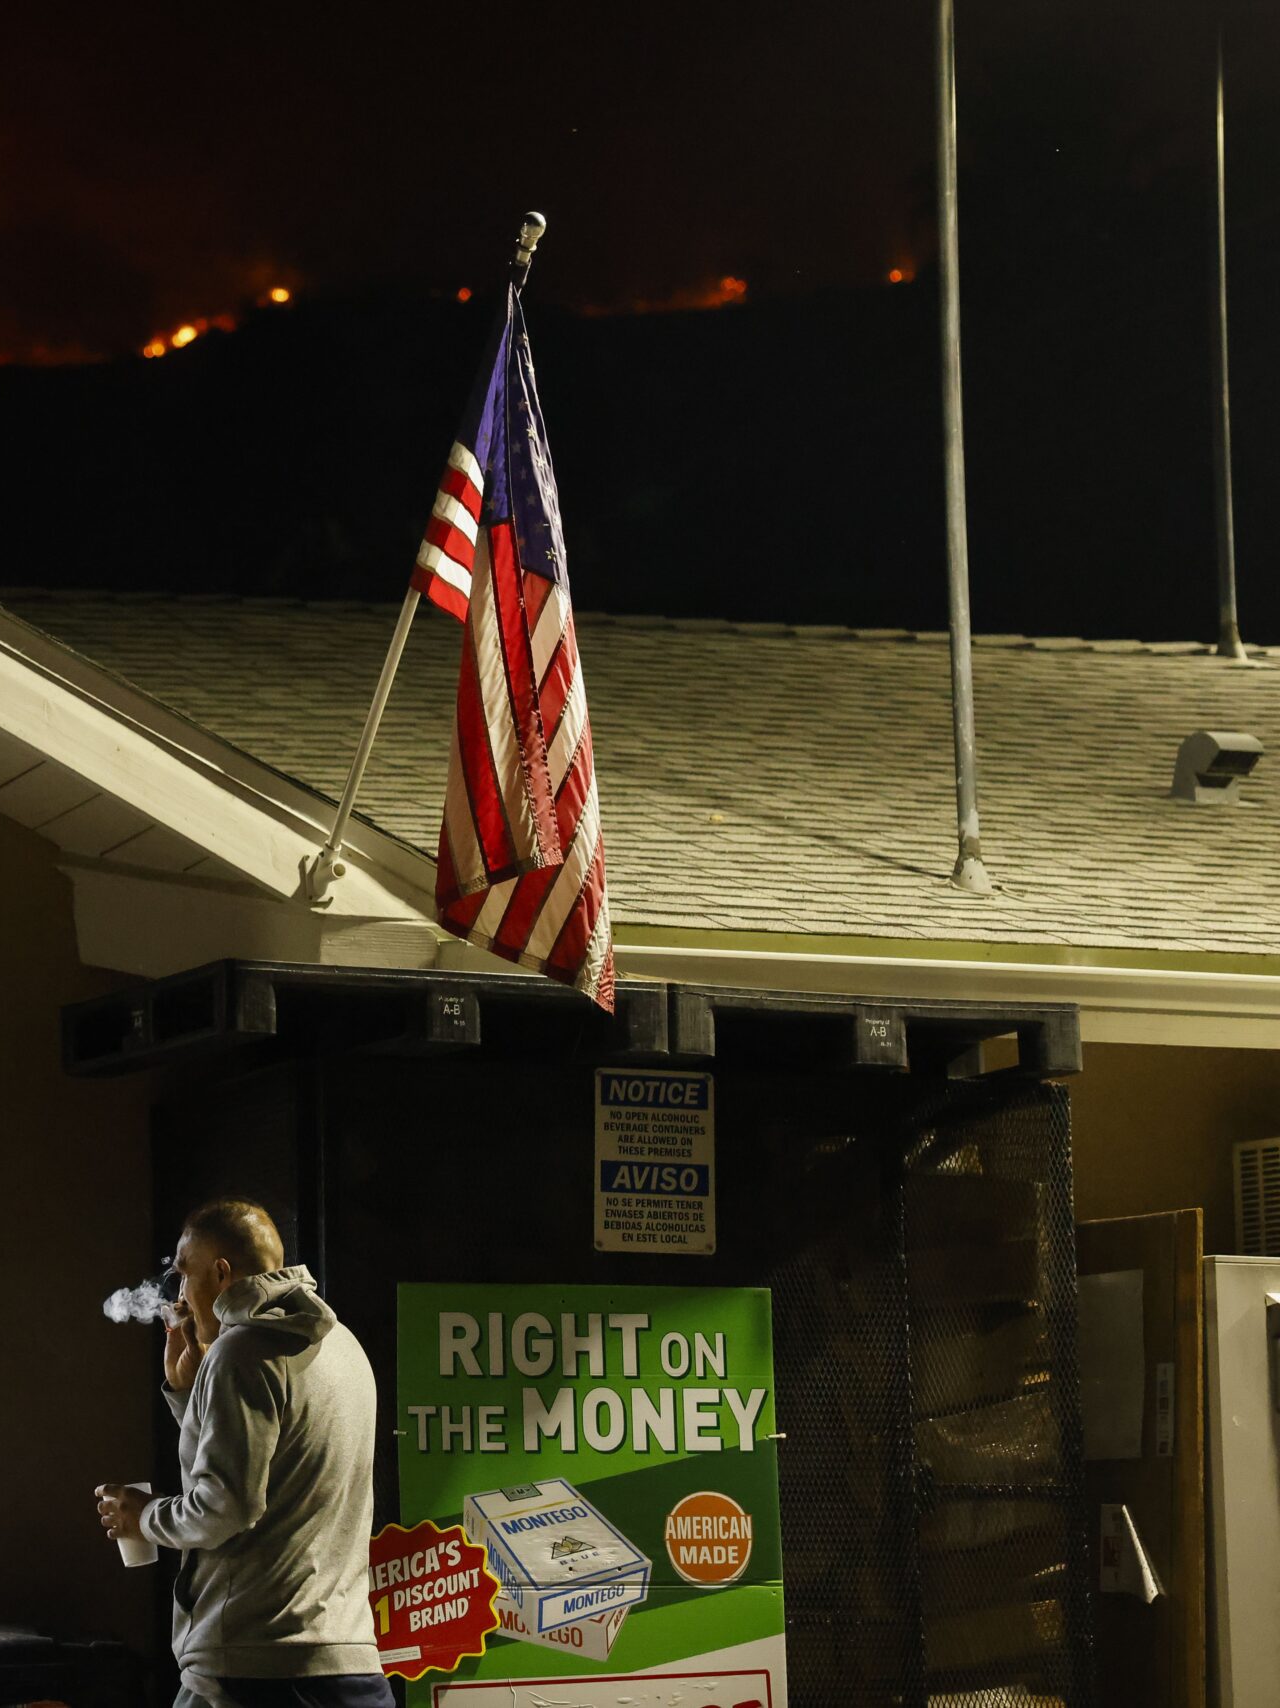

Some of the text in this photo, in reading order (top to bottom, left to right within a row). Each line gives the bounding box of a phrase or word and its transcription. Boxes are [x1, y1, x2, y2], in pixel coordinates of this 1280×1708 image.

[443, 1003, 461, 1015] A-B
[870, 1026, 887, 1037] A-B
[609, 1078, 701, 1105] NOTICE
[609, 1110, 700, 1124] NO OPEN ALCOHOLIC
[604, 1122, 706, 1135] BEVERAGE CONTAINERS
[617, 1135, 693, 1146] ARE ALLOWED ON
[618, 1146, 692, 1157] THESE PREMISES
[611, 1164, 699, 1192] AVISO
[606, 1197, 703, 1210] NO SE PERMITE TENER
[605, 1209, 705, 1222] ENVASES ABIERTOS DE
[604, 1220, 706, 1233] BEBIDAS ALCOHOLICAS
[622, 1233, 688, 1244] EN ESTE LOCAL
[438, 1311, 726, 1378] RIGHT ON
[407, 1387, 766, 1453] THE MONEY
[500, 1505, 589, 1535] MONTEGO
[666, 1515, 752, 1540] AMERICAN
[679, 1545, 739, 1565] MADE
[393, 1567, 480, 1611] DISCOUNT
[563, 1583, 625, 1615] MONTEGO
[498, 1608, 583, 1649] MOEGO
